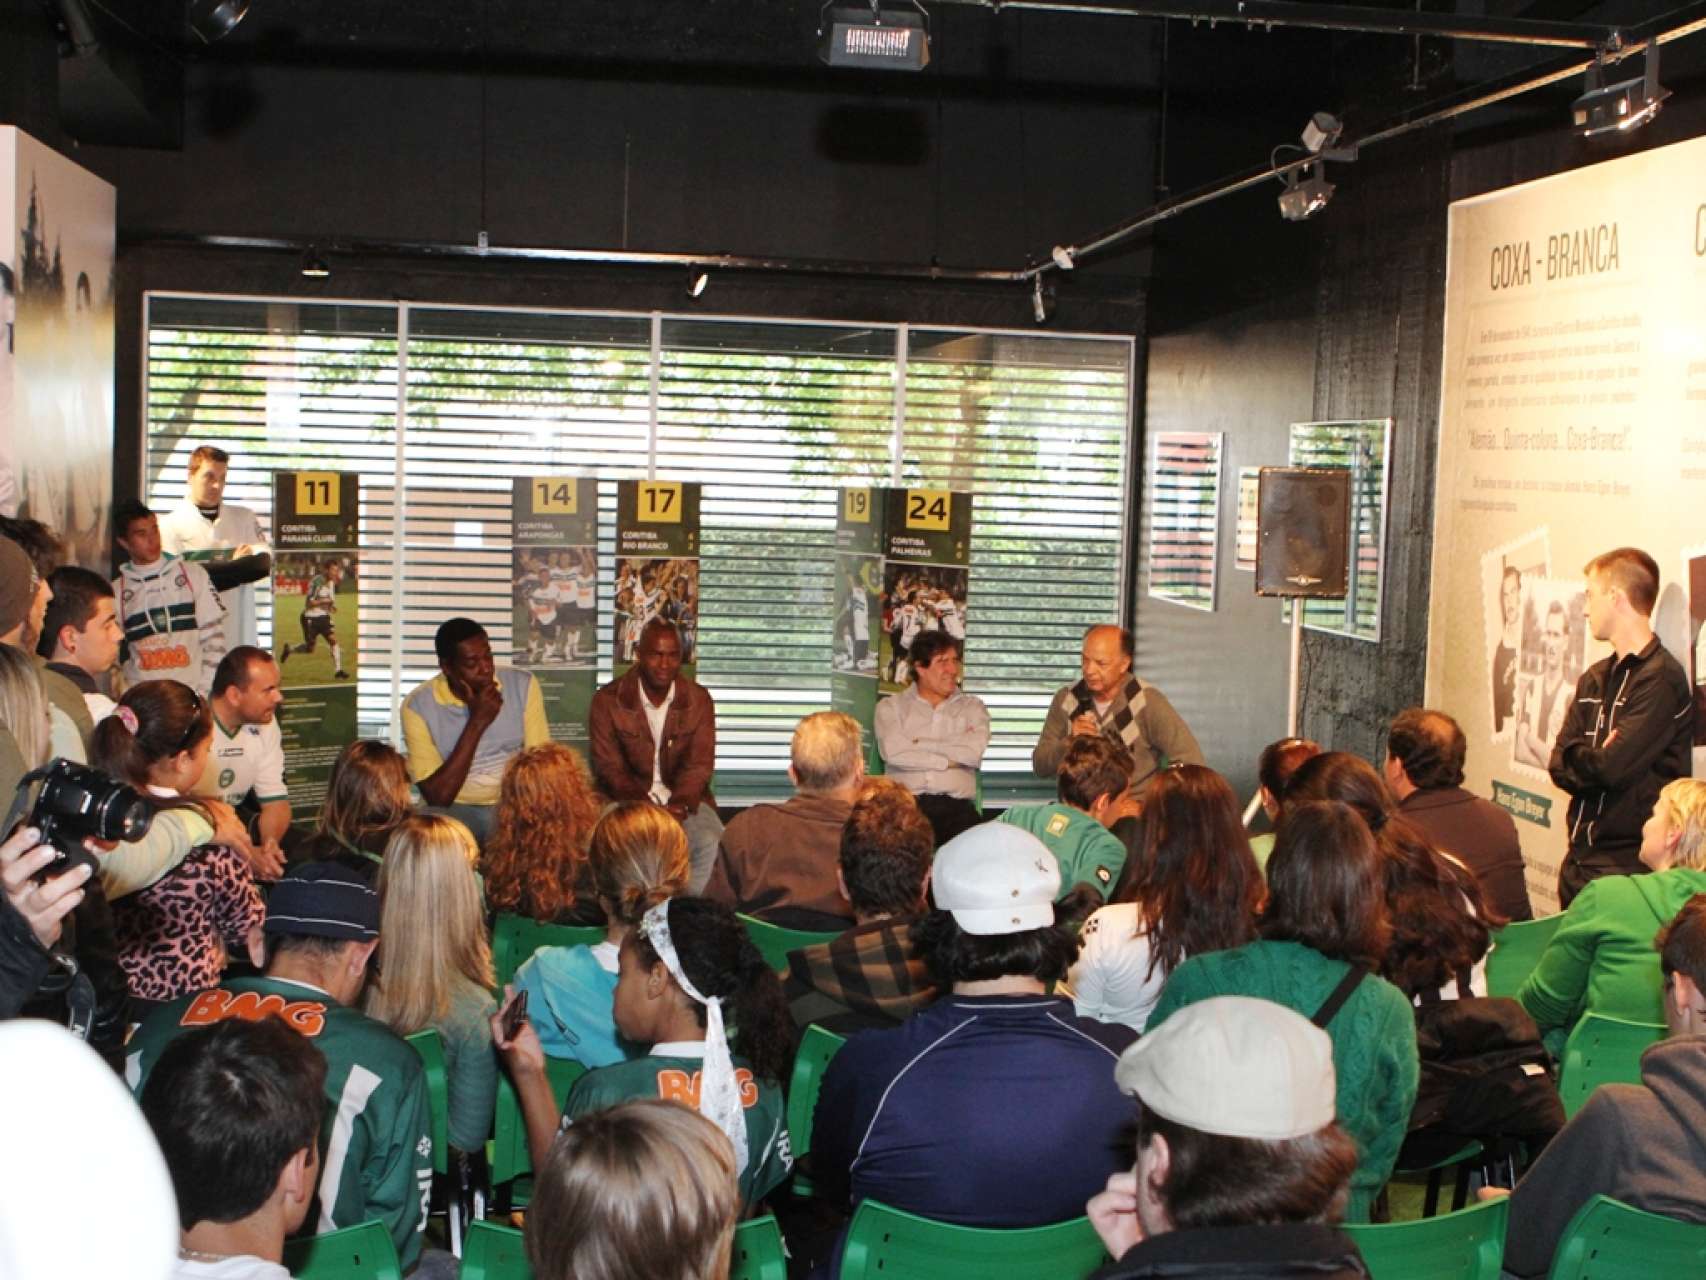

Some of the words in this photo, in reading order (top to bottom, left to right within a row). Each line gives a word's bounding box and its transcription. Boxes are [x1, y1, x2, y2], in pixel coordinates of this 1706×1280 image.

[1490, 240, 1531, 291] COXA
[1547, 222, 1619, 281] BRANCA
[304, 481, 329, 506] 11
[537, 483, 571, 506] 14
[645, 488, 675, 513] 17
[848, 492, 866, 514] 19
[909, 496, 947, 521] 24
[622, 541, 638, 550] RIO
[639, 541, 669, 550] BRANCO
[891, 546, 932, 557] PALMEIRAS
[180, 988, 327, 1037] BMG
